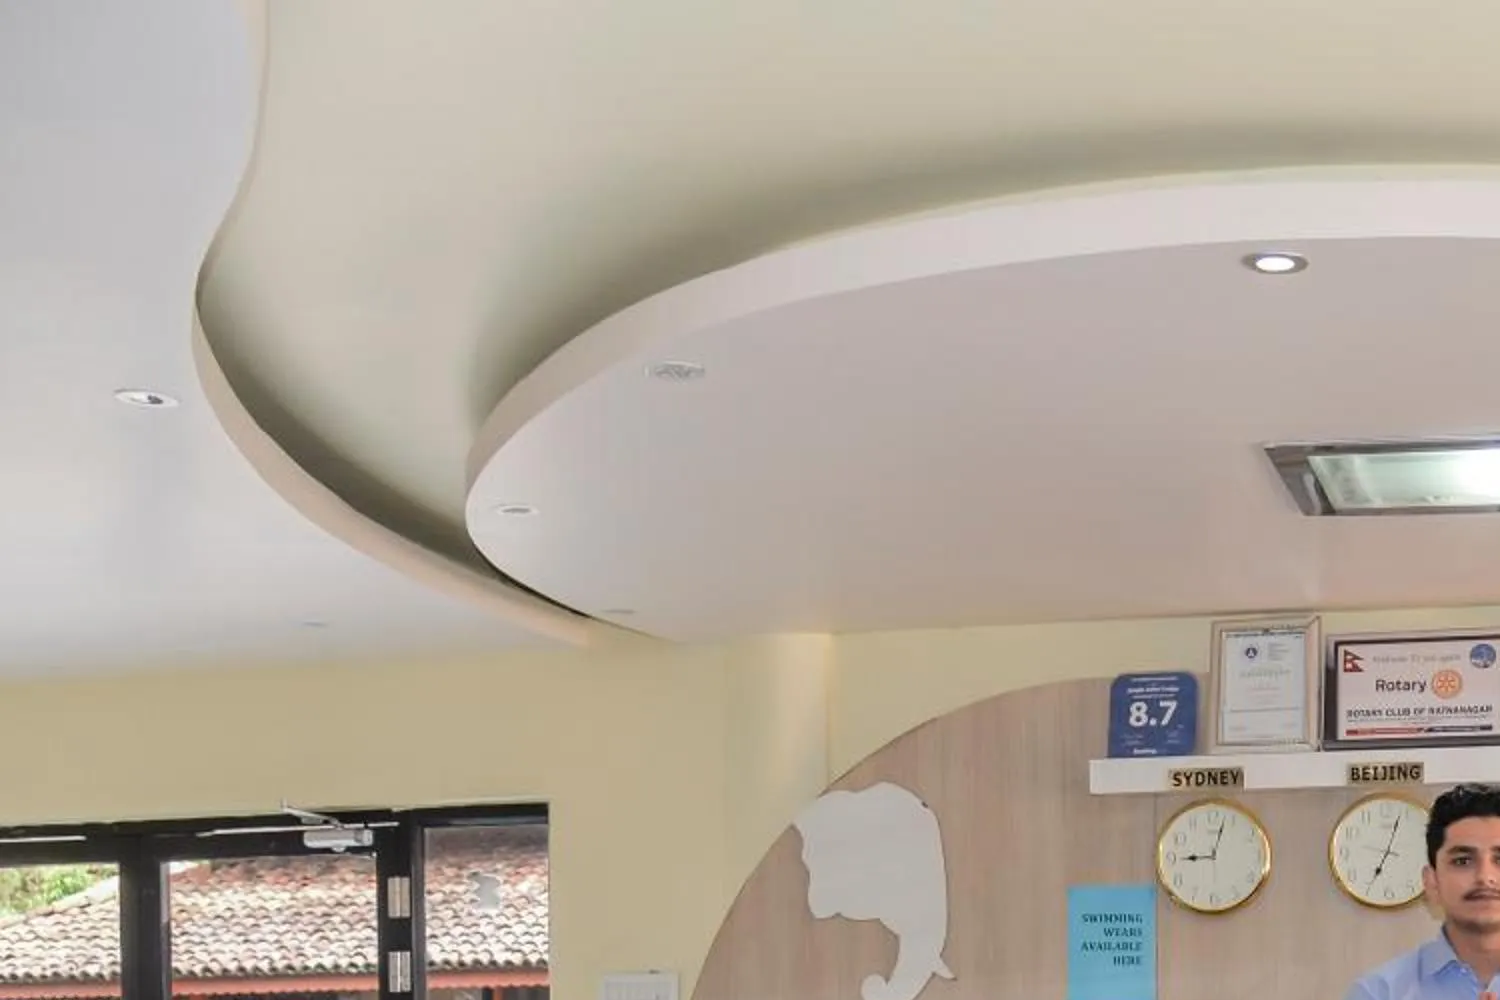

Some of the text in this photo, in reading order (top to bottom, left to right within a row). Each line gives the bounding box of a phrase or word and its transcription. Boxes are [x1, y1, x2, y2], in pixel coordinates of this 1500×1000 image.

[1375, 679, 1427, 693] Rotary
[1128, 700, 1177, 727] 8.7
[1385, 708, 1411, 717] CLUB
[1413, 707, 1425, 716] OF
[1172, 771, 1239, 787] SYDNEY
[1350, 765, 1421, 781] BEIJING
[1082, 913, 1143, 923] SWIMMING
[1082, 941, 1142, 951] AVAILABLE
[1113, 955, 1141, 965] HERE
